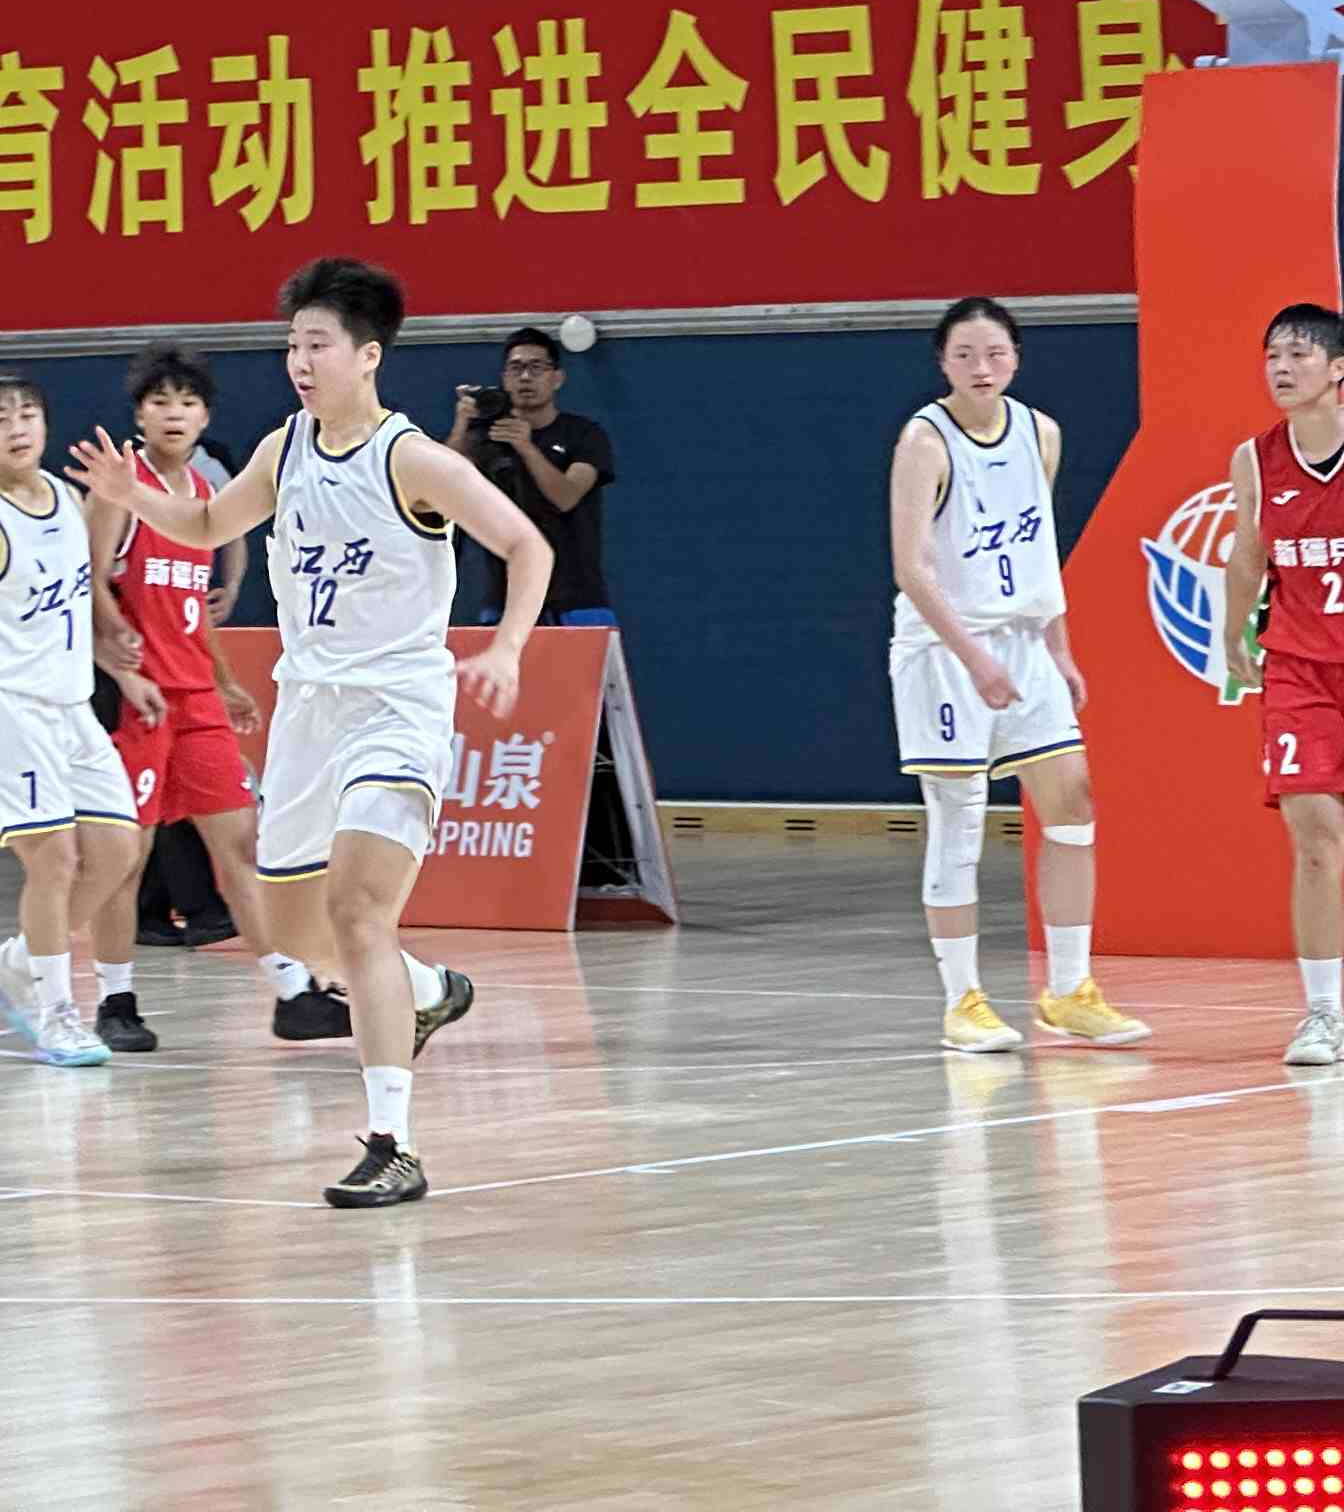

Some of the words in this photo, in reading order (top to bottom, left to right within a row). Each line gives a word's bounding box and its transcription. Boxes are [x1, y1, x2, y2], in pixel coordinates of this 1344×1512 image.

[998, 554, 1014, 597] 9
[1321, 571, 1344, 615] 2
[183, 596, 201, 635] 9
[308, 576, 338, 627] 12
[59, 609, 73, 651] 7
[940, 703, 955, 742] 9
[1278, 732, 1302, 776] 2
[20, 770, 36, 809] 7
[136, 768, 157, 806] 9
